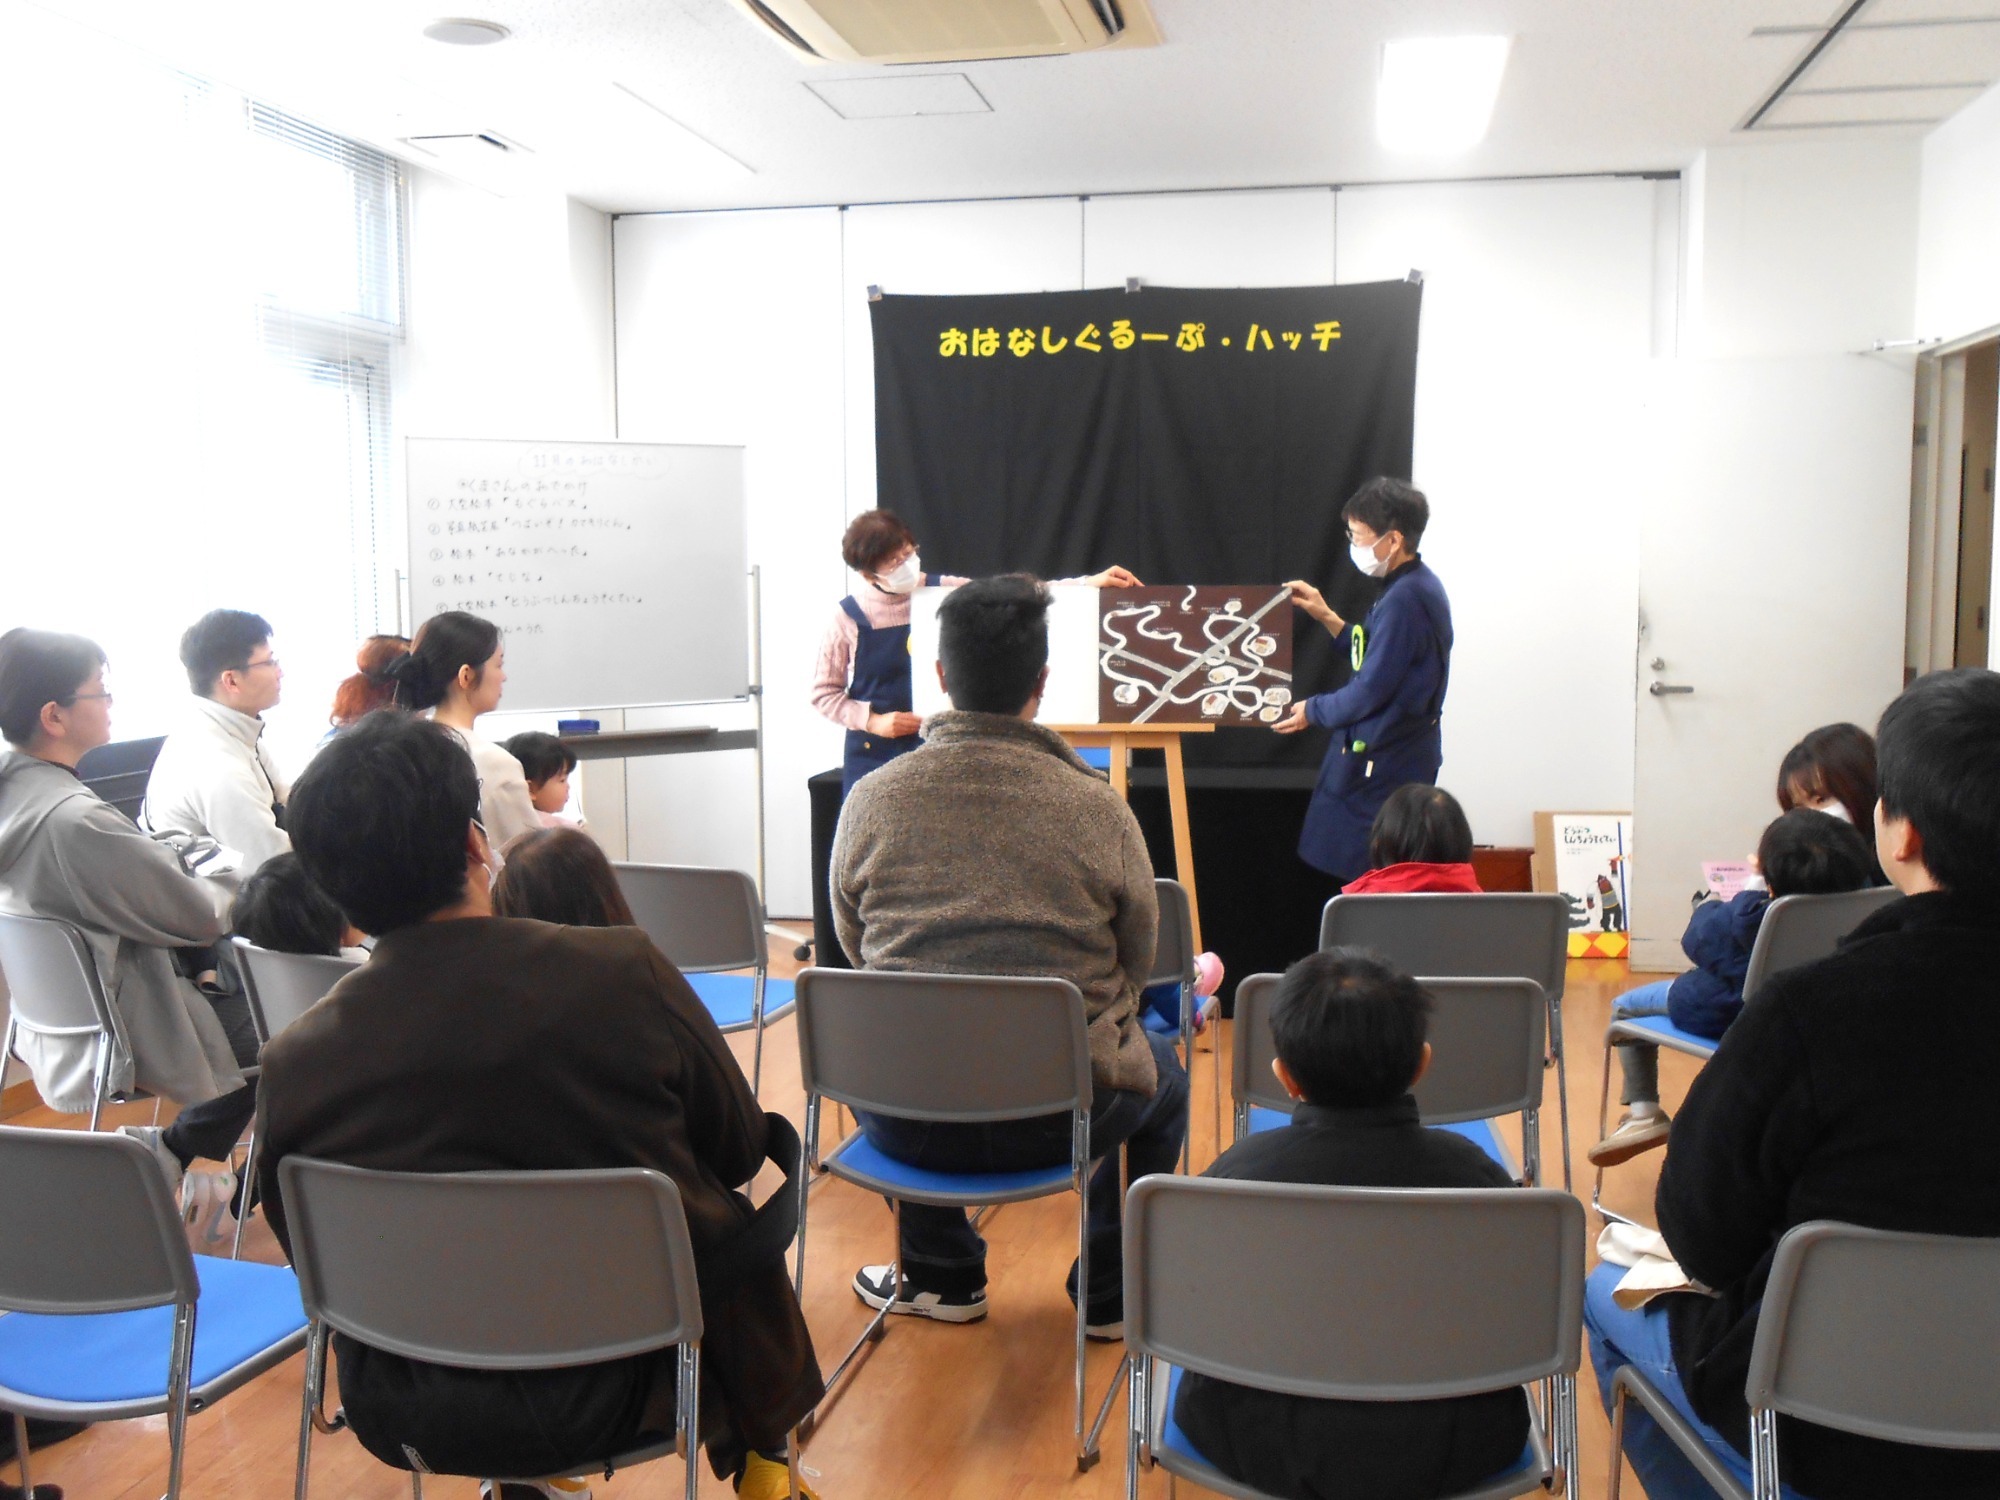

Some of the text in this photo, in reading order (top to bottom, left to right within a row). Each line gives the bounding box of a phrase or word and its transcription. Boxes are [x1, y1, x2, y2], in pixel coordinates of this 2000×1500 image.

[939, 318, 1342, 358] おはなしぐるーぷ・ハッチ
